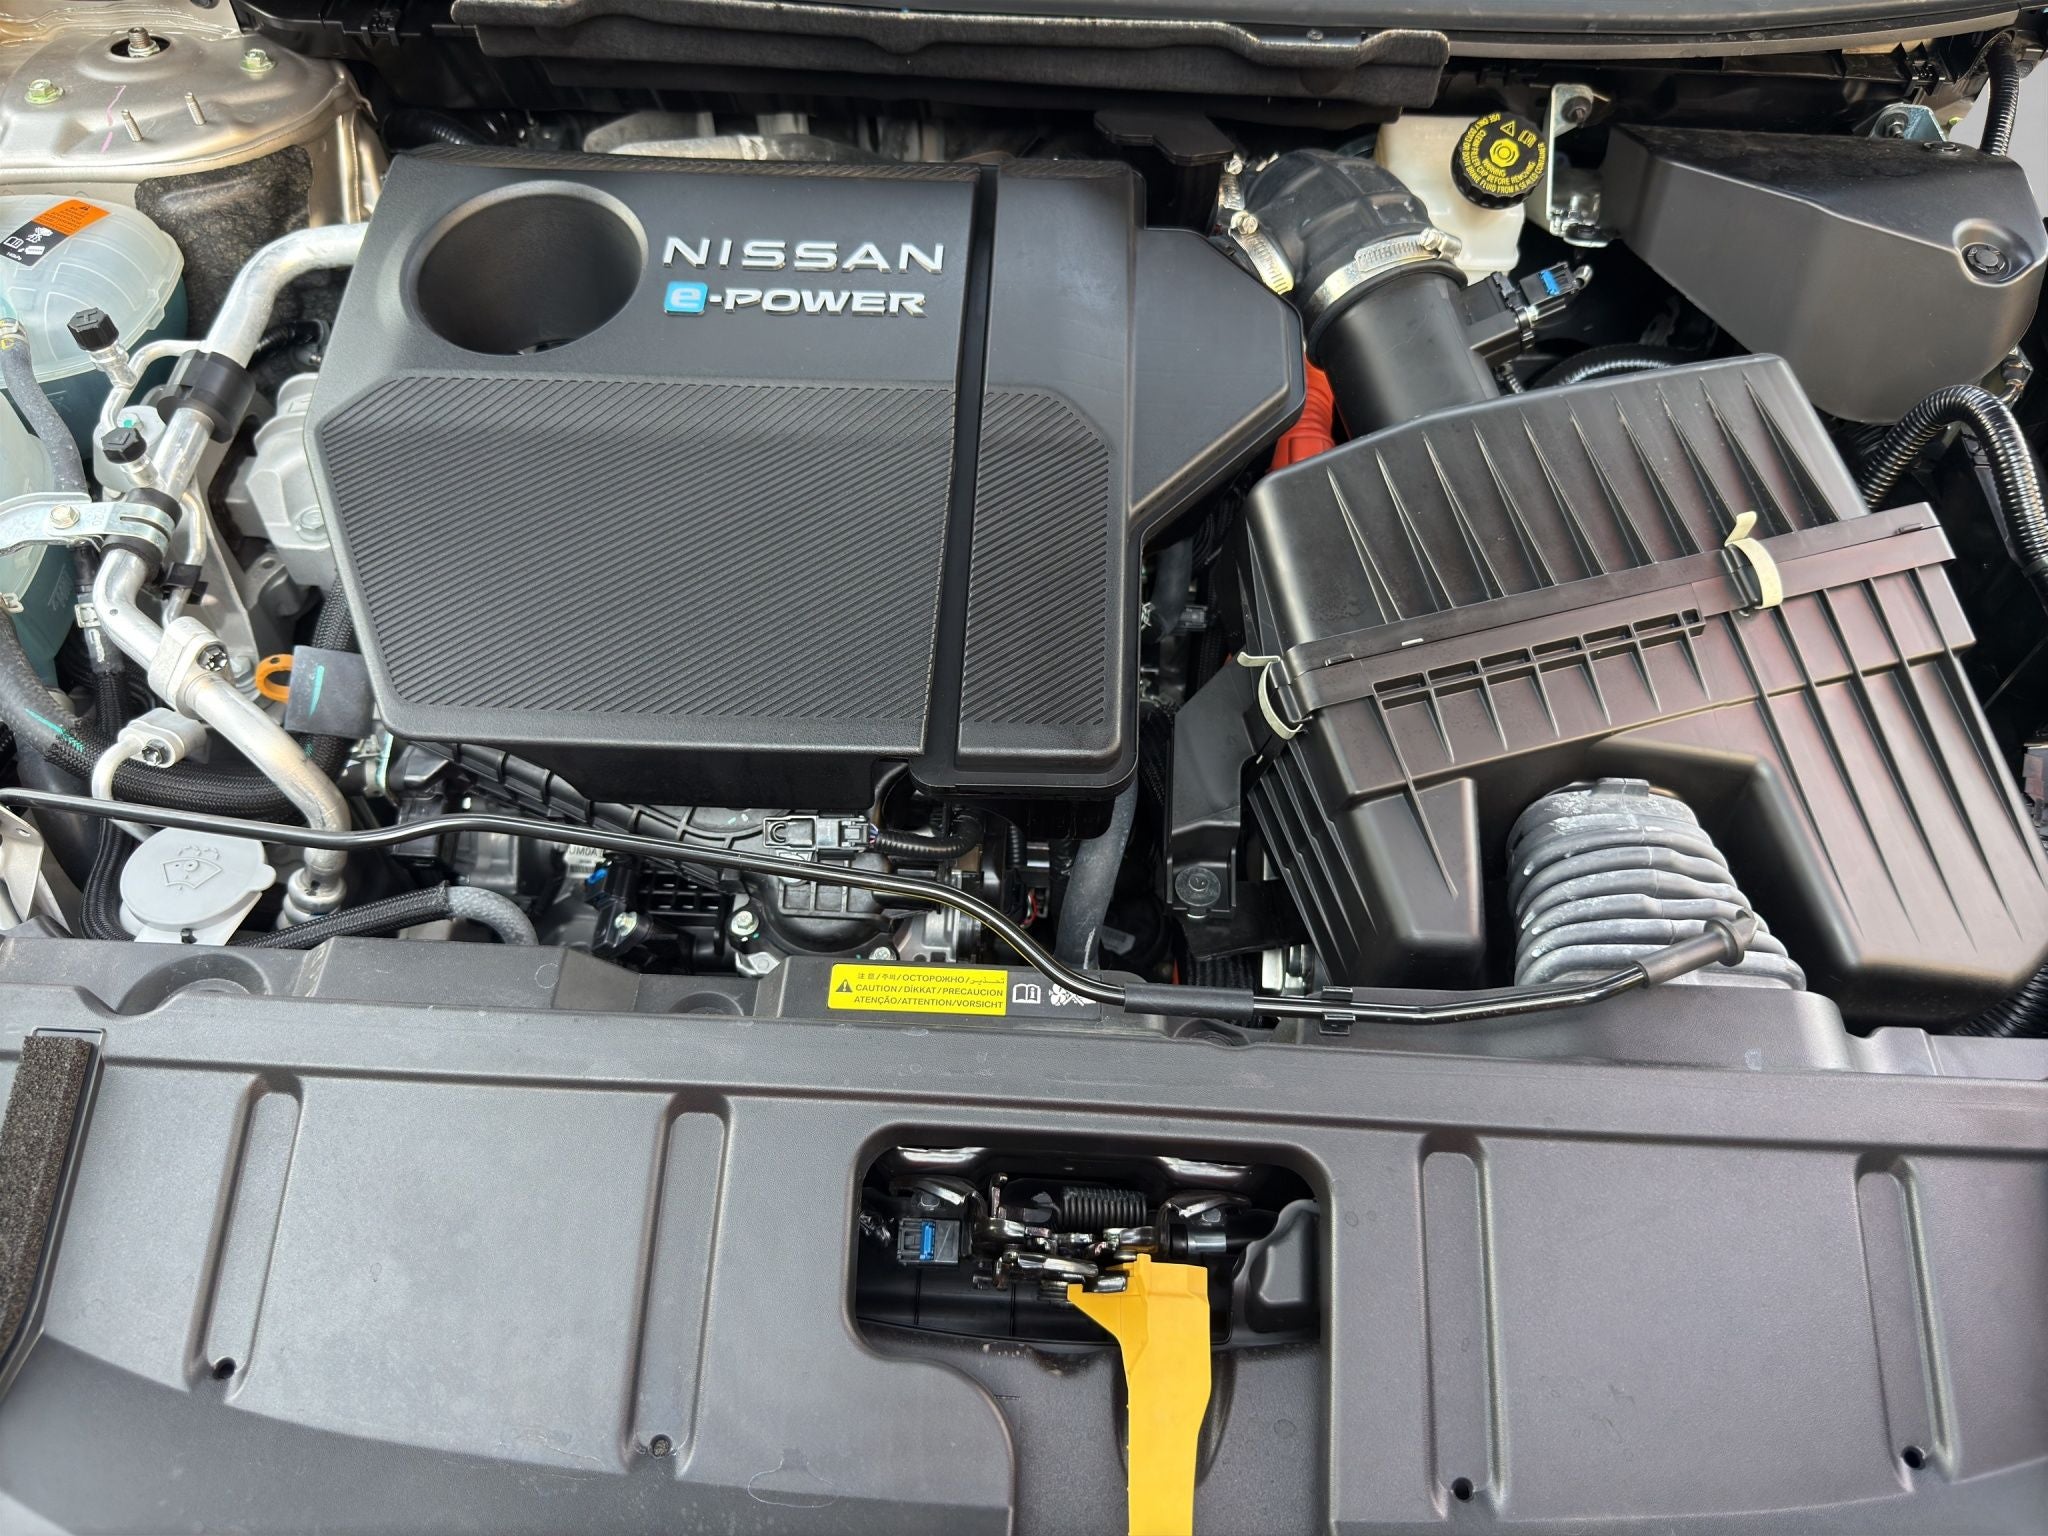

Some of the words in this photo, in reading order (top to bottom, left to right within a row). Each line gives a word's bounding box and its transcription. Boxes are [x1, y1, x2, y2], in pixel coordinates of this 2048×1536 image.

[1472, 130, 1487, 148] CLEAN
[1471, 148, 1480, 167] FILLER
[1466, 165, 1481, 183] BRAKE
[1480, 179, 1496, 192] FLUID
[1497, 185, 1514, 193] FROM
[1519, 172, 1538, 190] SEALED
[1535, 142, 1546, 174] CONTAINER
[1477, 165, 1488, 176] CAP
[1481, 158, 1506, 177] WARNING
[1510, 161, 1536, 184] REMOVING
[1487, 174, 1511, 185] BEFORE
[663, 236, 944, 273] NISSAN
[664, 280, 927, 316] e-POWER
